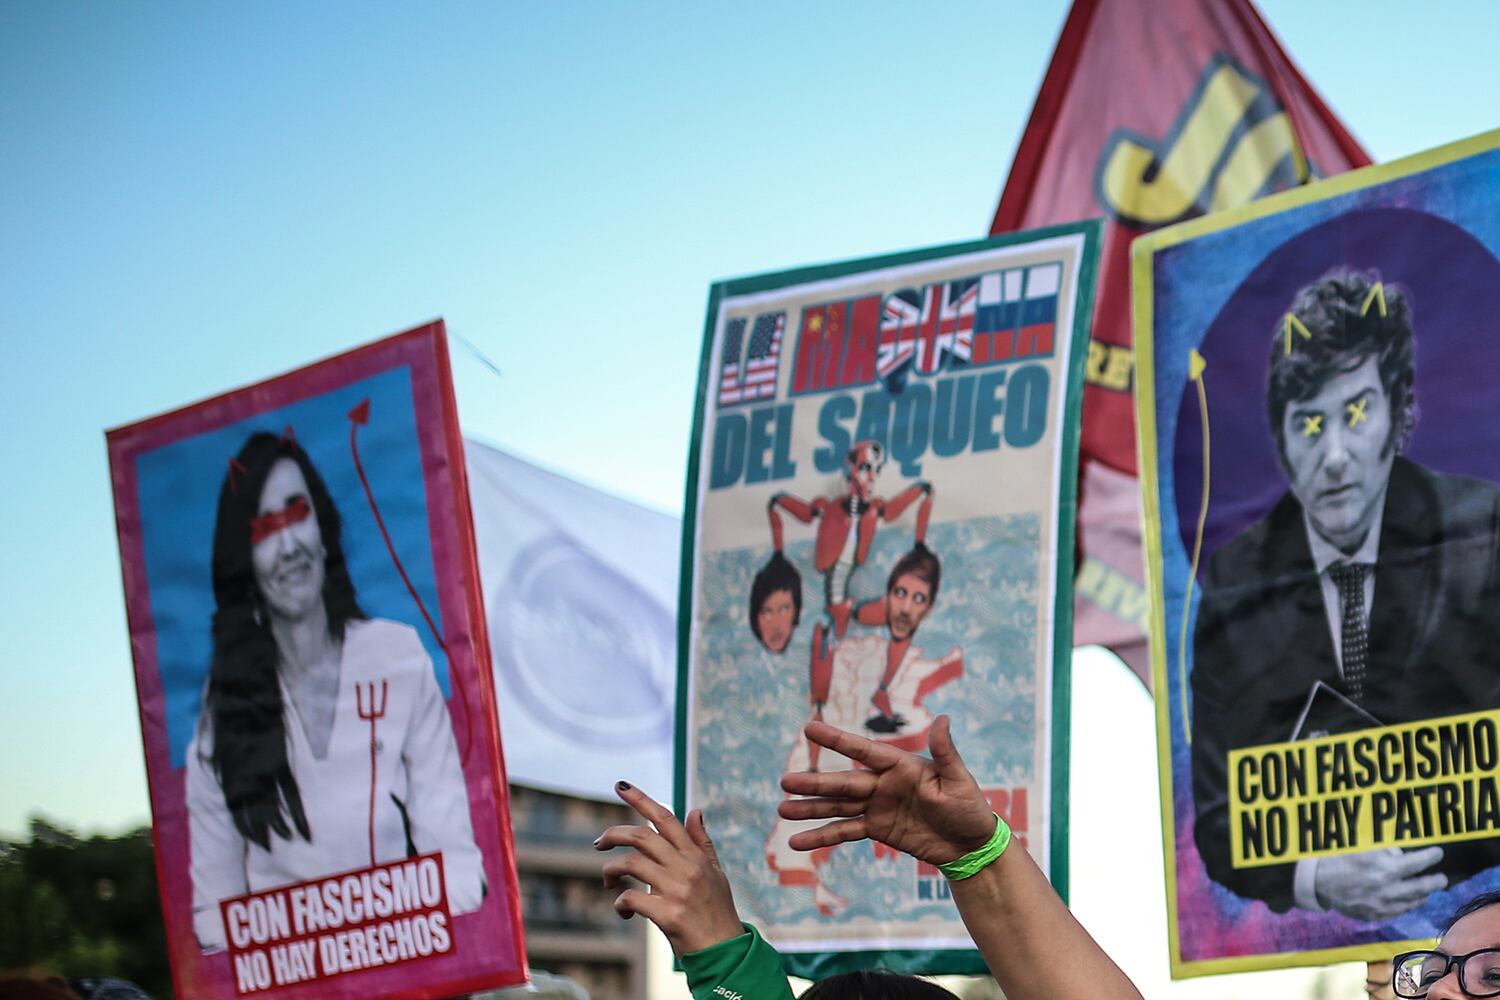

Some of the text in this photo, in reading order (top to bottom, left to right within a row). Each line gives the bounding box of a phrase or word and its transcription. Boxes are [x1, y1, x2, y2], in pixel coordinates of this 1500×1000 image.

[717, 308, 788, 408] LA
[708, 363, 1051, 490] DEL SAQUEO
[1237, 717, 1498, 804] CON FASCISMO
[1240, 805, 1289, 860] NO
[1297, 795, 1363, 853] HAY
[226, 857, 442, 949] CON FASCISMO
[234, 910, 451, 994] NO HAY DERECHOS
